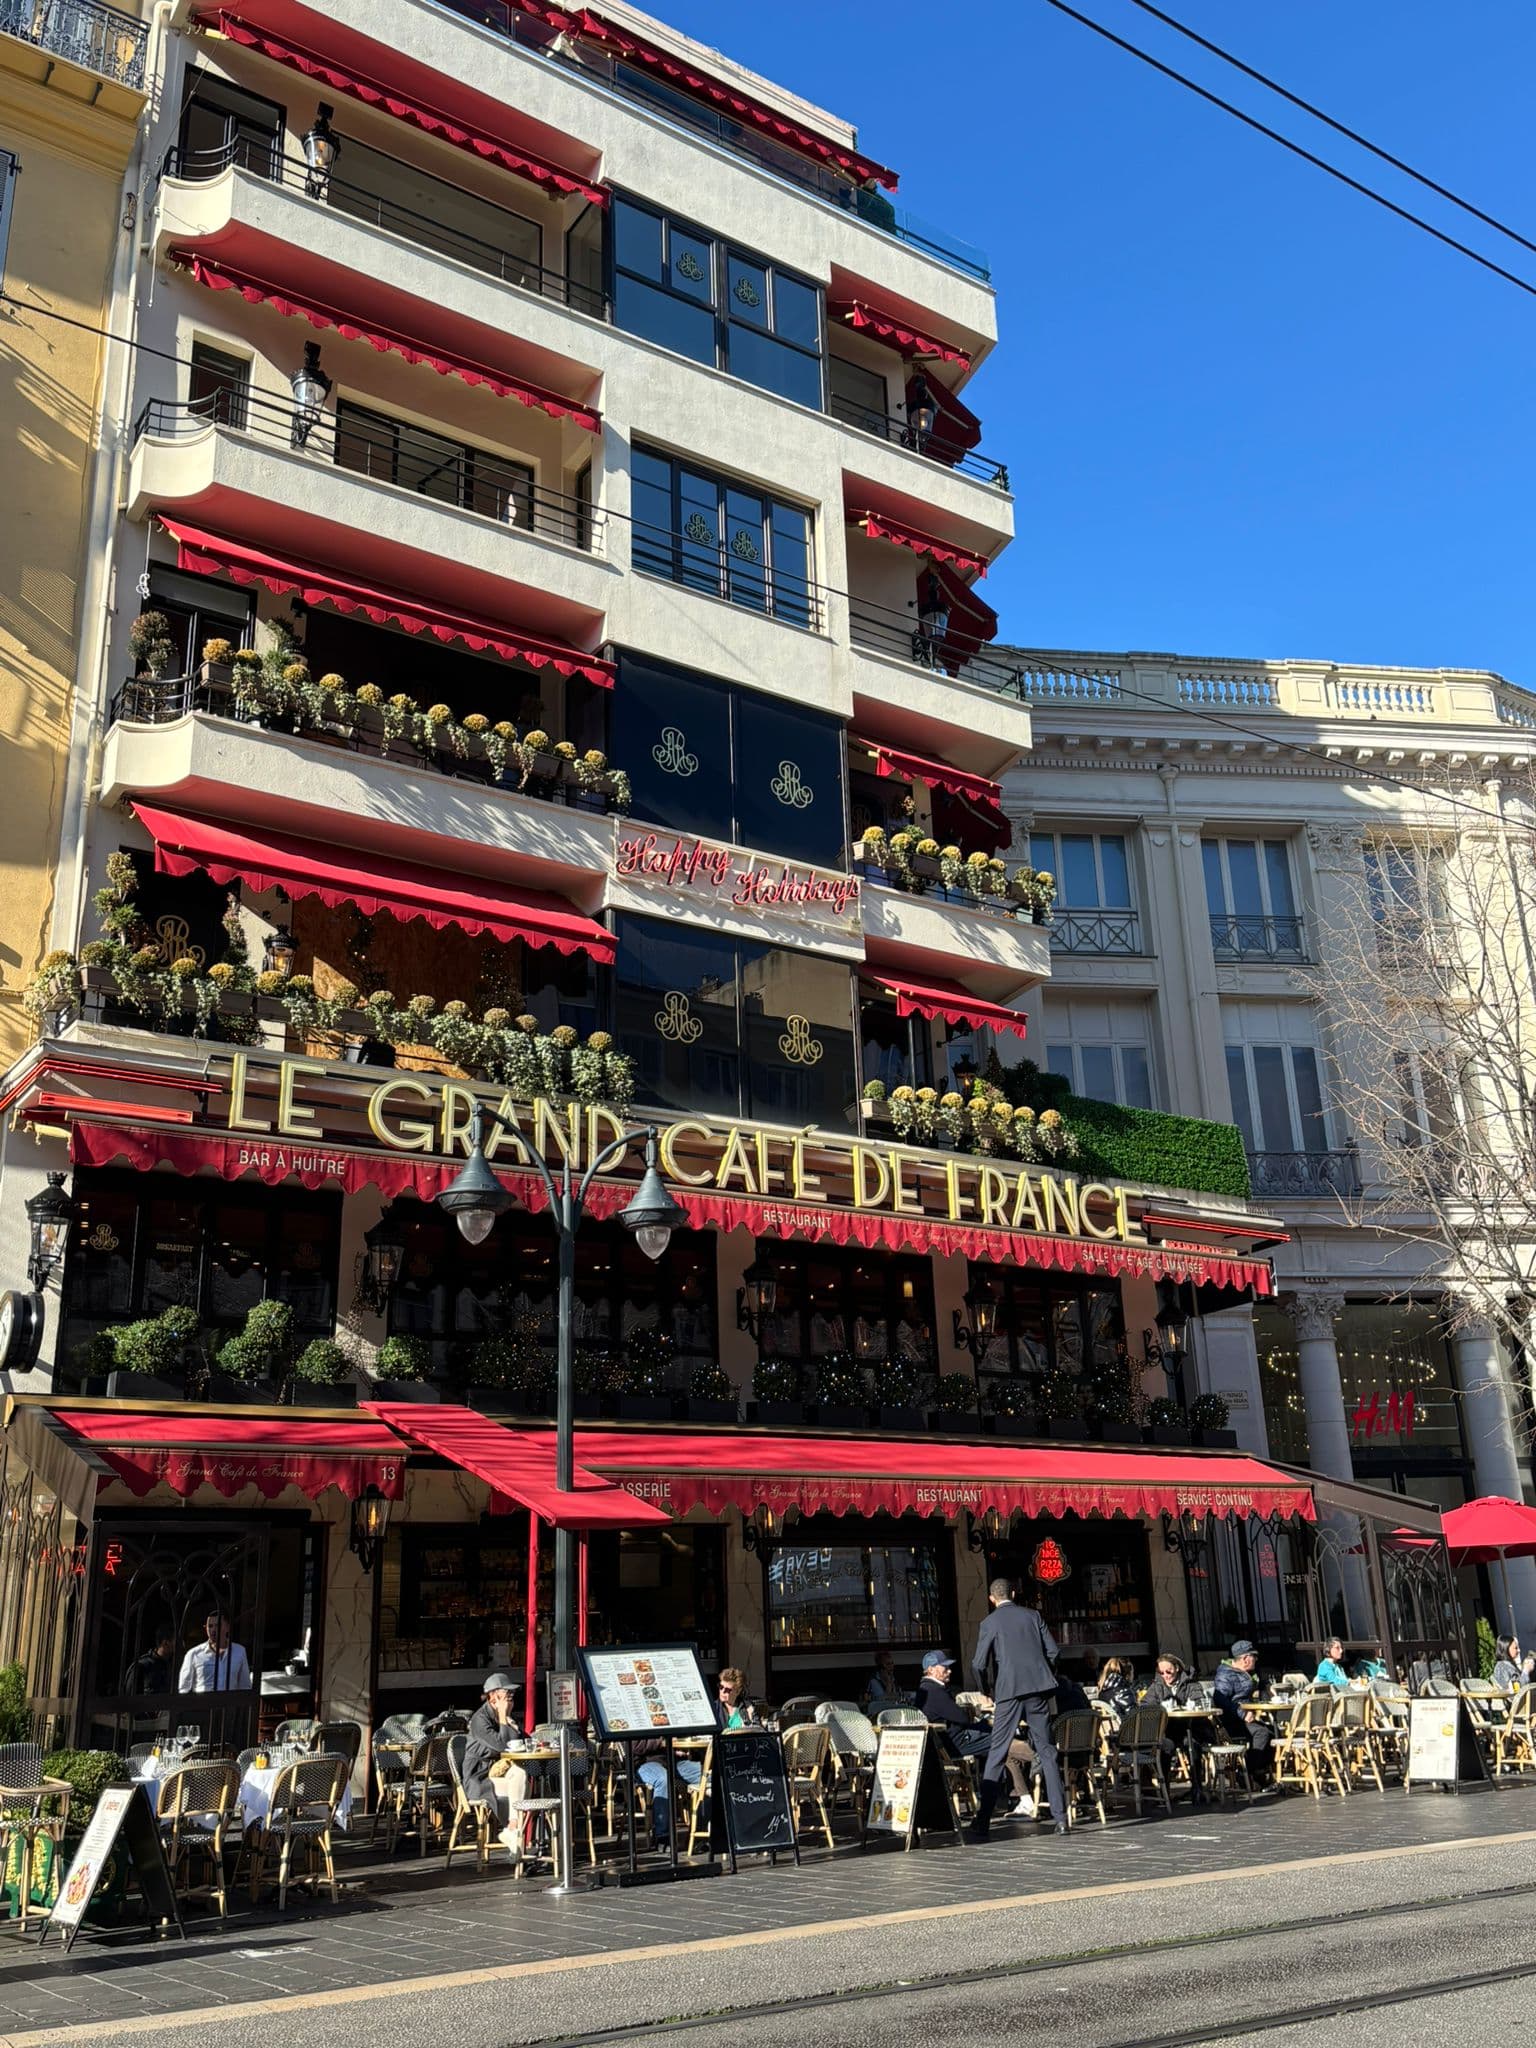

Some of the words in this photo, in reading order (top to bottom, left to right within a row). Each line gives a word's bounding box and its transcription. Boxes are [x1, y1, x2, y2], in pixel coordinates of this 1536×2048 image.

[617, 834, 734, 885] Happy
[732, 867, 861, 914] Holidays
[228, 1052, 327, 1138] LE
[369, 1079, 628, 1174] GRAND
[660, 1120, 828, 1201] CAFÉ
[852, 1144, 925, 1214] DE
[946, 1159, 1148, 1245] FRANCE
[239, 1150, 270, 1167] BAR
[763, 1209, 832, 1229] RESTAURANT
[1352, 1390, 1415, 1439] H&M
[154, 1461, 171, 1475] Le
[176, 1460, 218, 1479] Grand
[219, 1461, 245, 1480] Café
[246, 1464, 258, 1477] de
[262, 1463, 304, 1478] France
[381, 1466, 396, 1481] 13
[917, 1488, 983, 1502] RESTAURANT
[1177, 1493, 1213, 1506] SERVICE
[1040, 1559, 1063, 1569] PIZZA
[1041, 1568, 1063, 1578] SHOP
